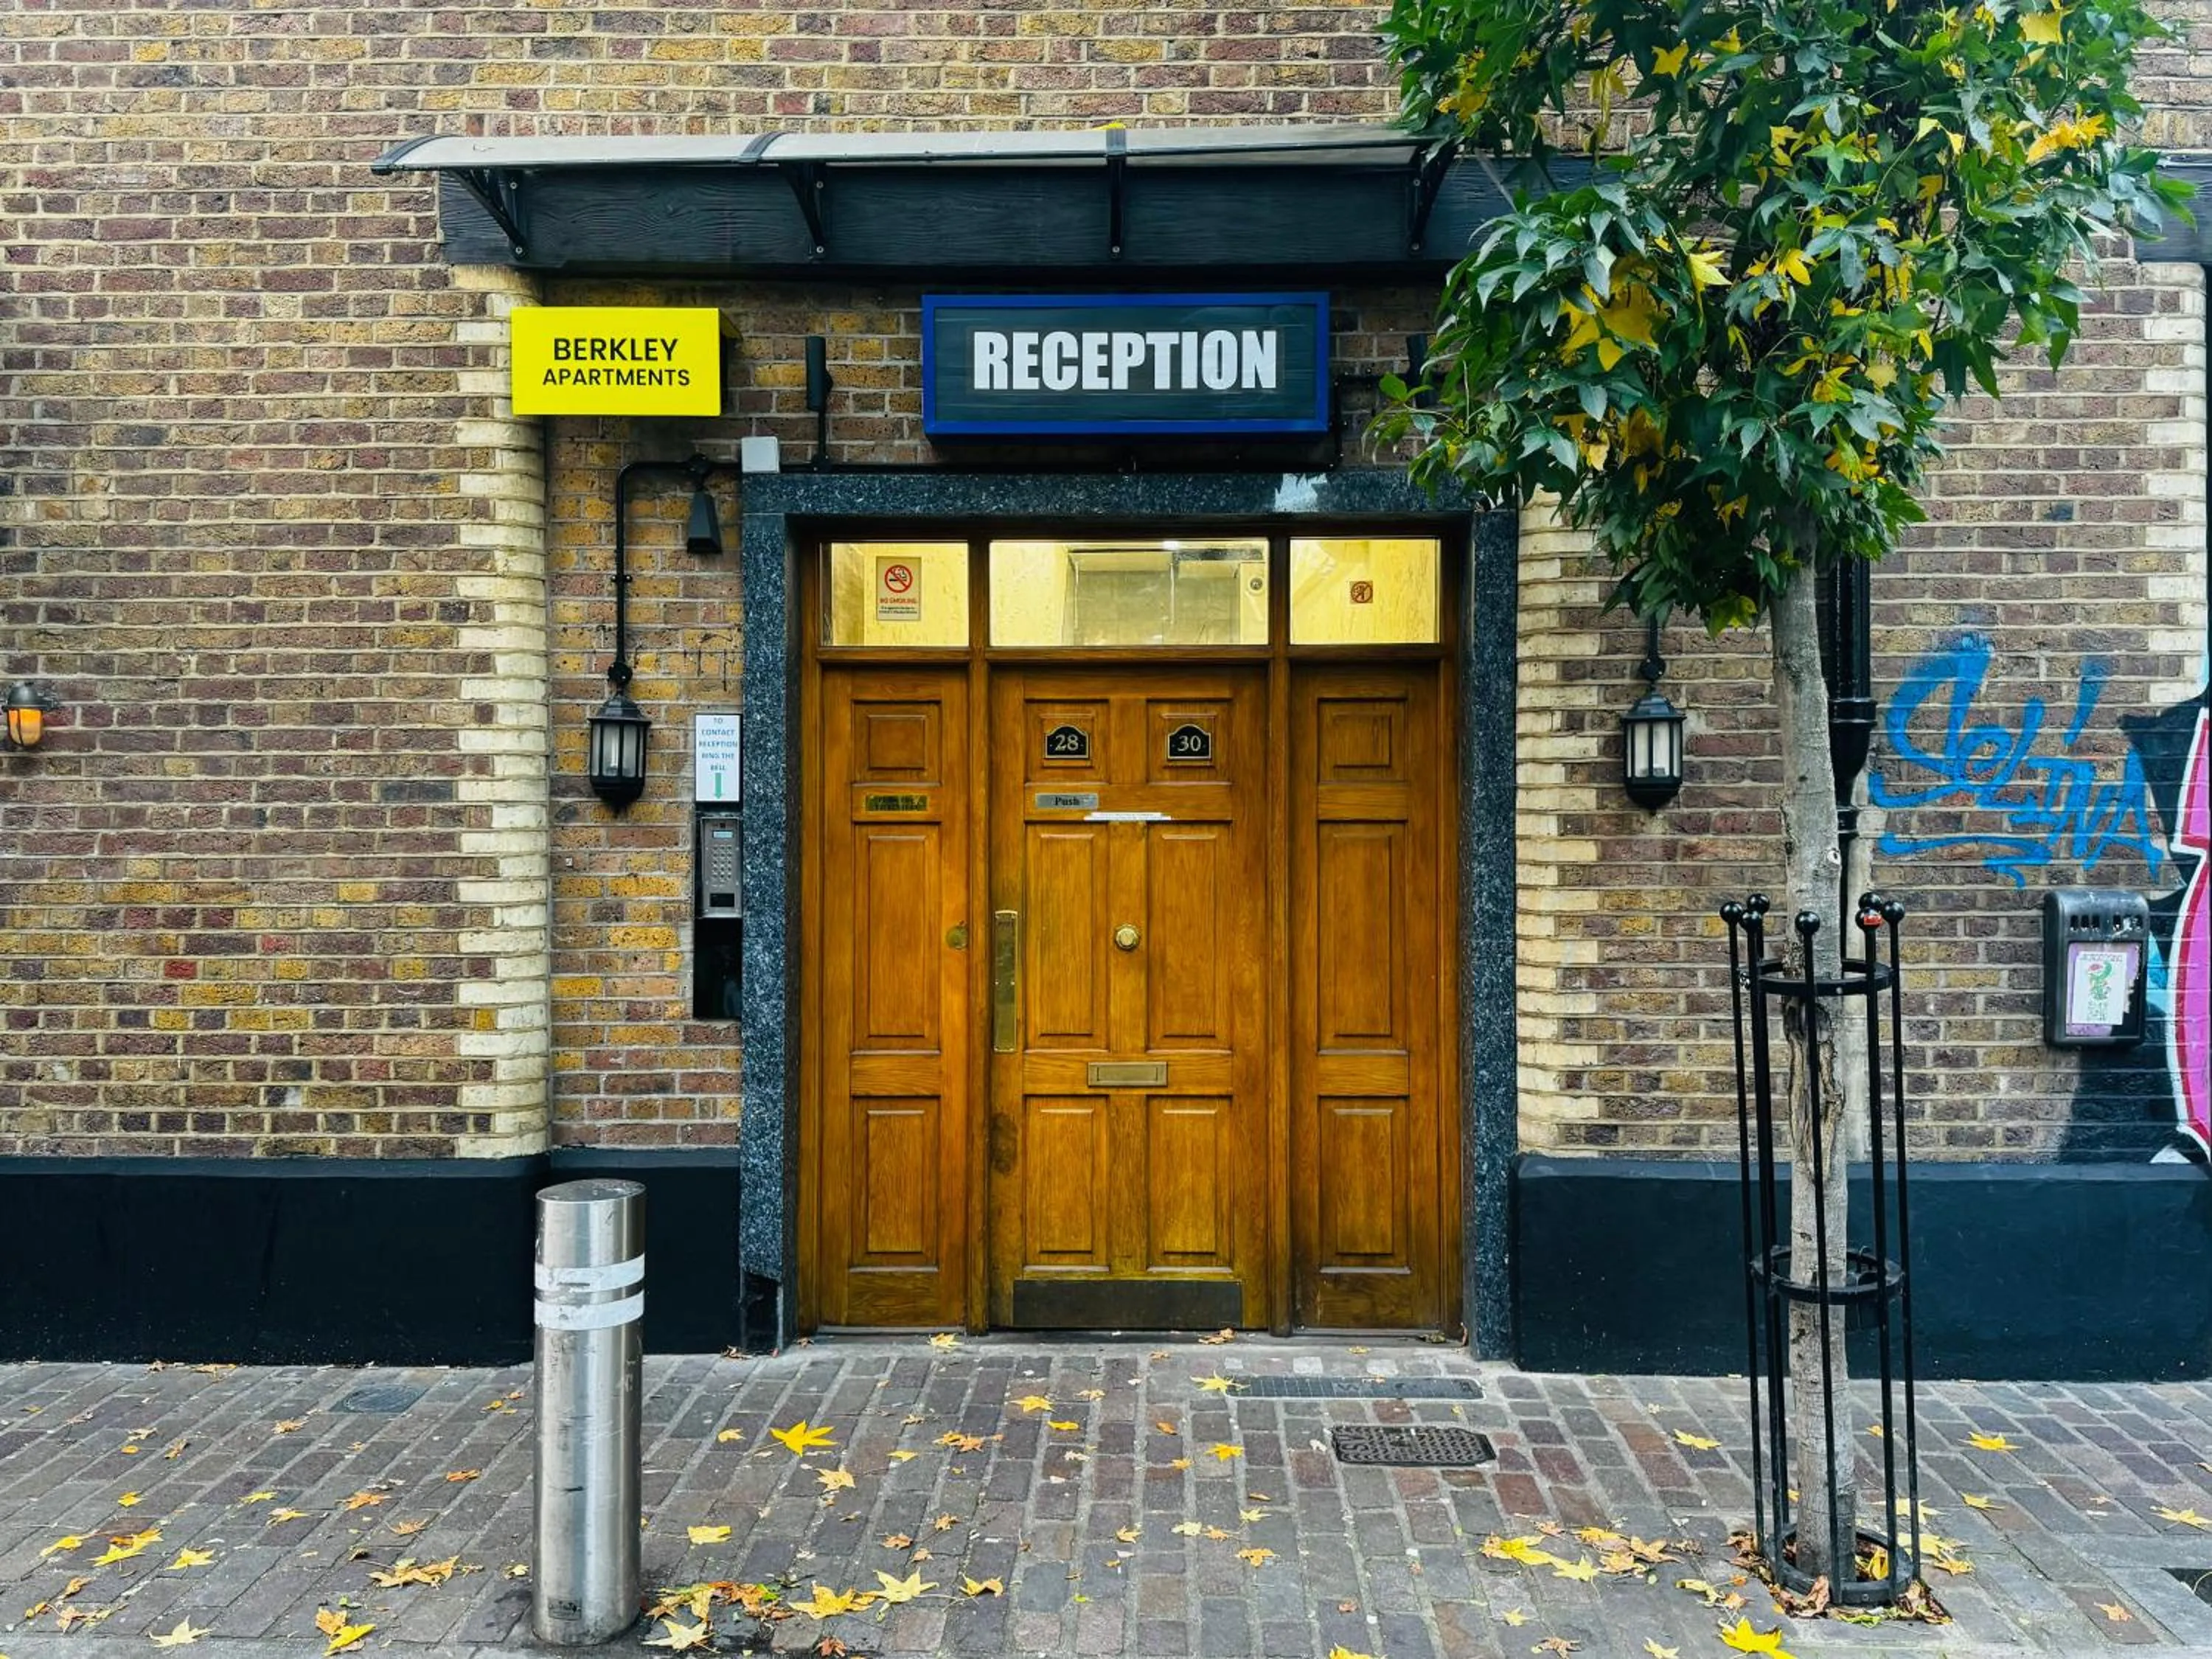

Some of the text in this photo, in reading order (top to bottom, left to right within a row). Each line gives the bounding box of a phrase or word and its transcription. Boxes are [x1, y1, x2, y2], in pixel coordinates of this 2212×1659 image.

[554, 338, 678, 361] BERKLEY
[973, 330, 1277, 391] RECEPTION
[542, 369, 690, 386] APARTMENTS
[1055, 734, 1079, 751] 28
[1178, 735, 1202, 752] 30
[1055, 796, 1080, 806] Push
